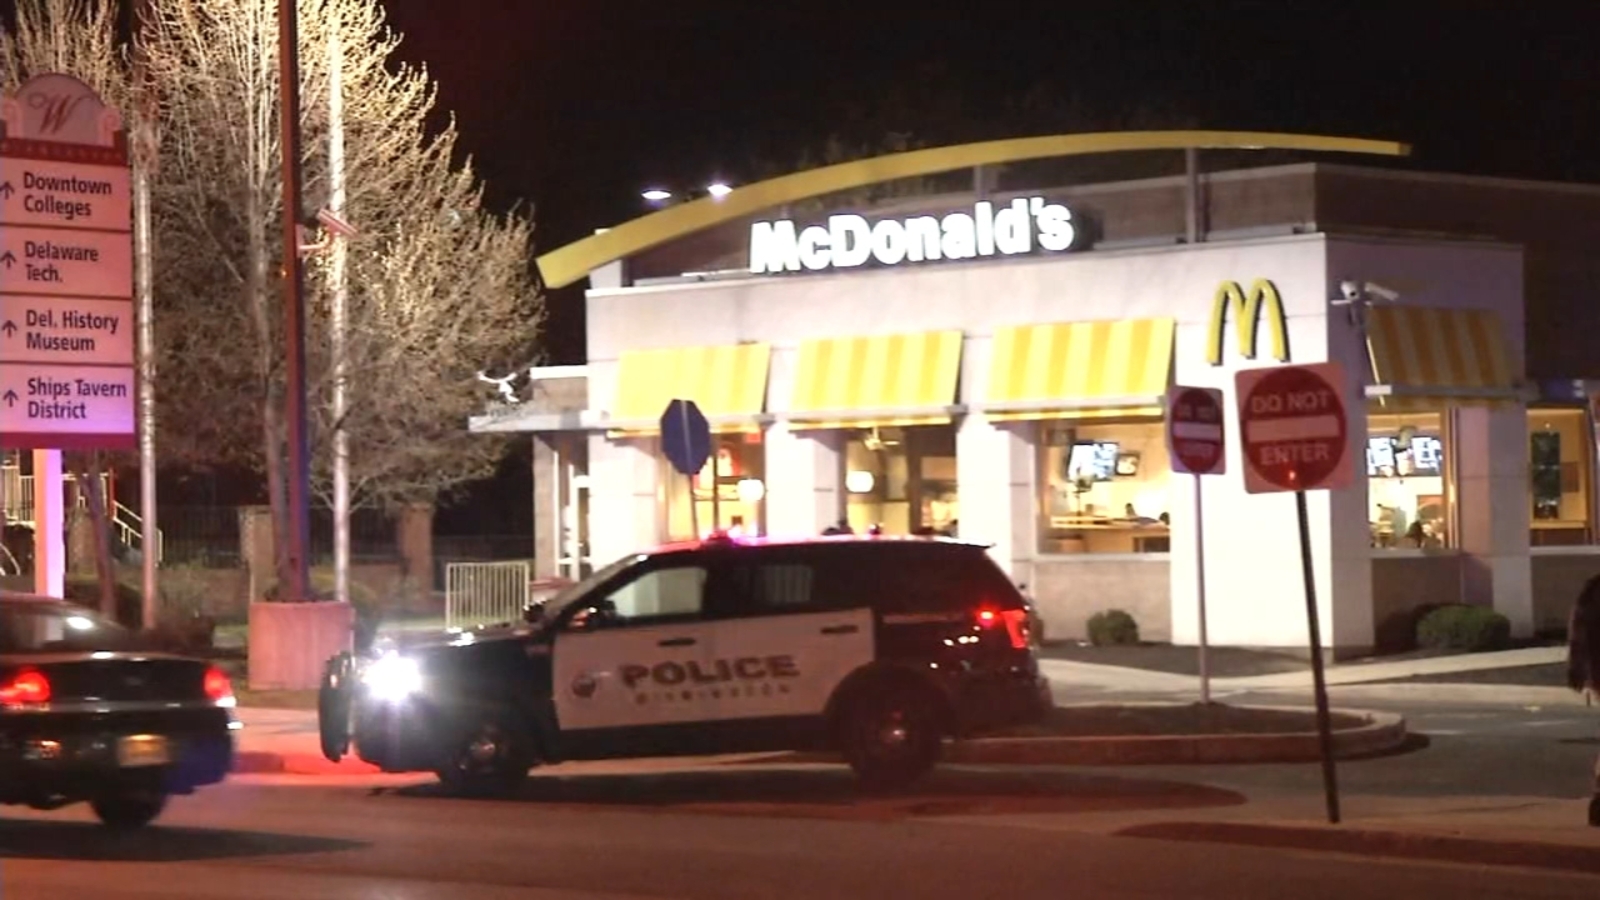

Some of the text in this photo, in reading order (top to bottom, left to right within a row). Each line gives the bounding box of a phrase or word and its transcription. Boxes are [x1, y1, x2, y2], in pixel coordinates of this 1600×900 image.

[23, 171, 113, 195] Downtown
[24, 195, 92, 220] Colleges
[750, 197, 1075, 274] McDonald's
[25, 241, 100, 262] Delaware
[26, 264, 63, 283] Tech.
[26, 310, 119, 335] Del. History
[26, 332, 96, 351] Museum
[28, 377, 127, 400] Ships Tavern
[28, 401, 87, 419] District
[1252, 390, 1331, 414] DO NOT
[1260, 443, 1330, 466] ENTER
[619, 655, 800, 688] POLICE
